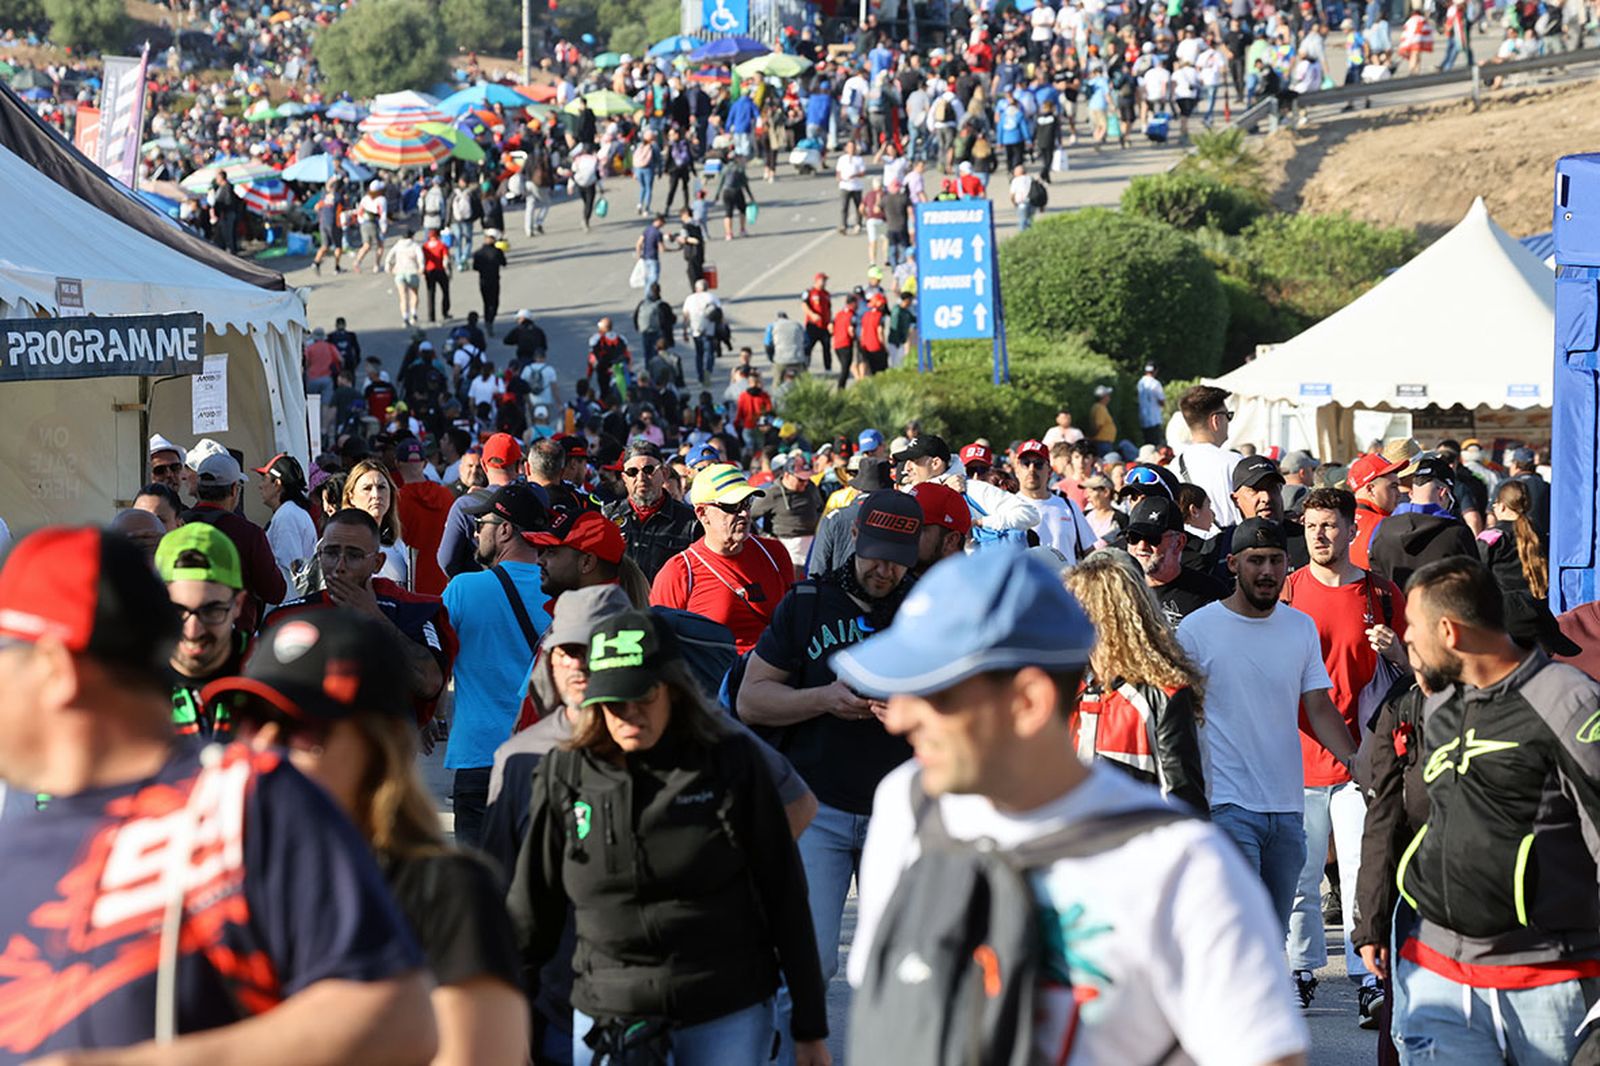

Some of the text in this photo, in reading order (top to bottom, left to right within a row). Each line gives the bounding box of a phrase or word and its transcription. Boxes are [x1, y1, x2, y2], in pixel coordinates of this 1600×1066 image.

[929, 238, 963, 260] W4
[934, 305, 963, 329] Q5
[7, 327, 198, 367] PROGRAMME
[965, 447, 985, 457] 93
